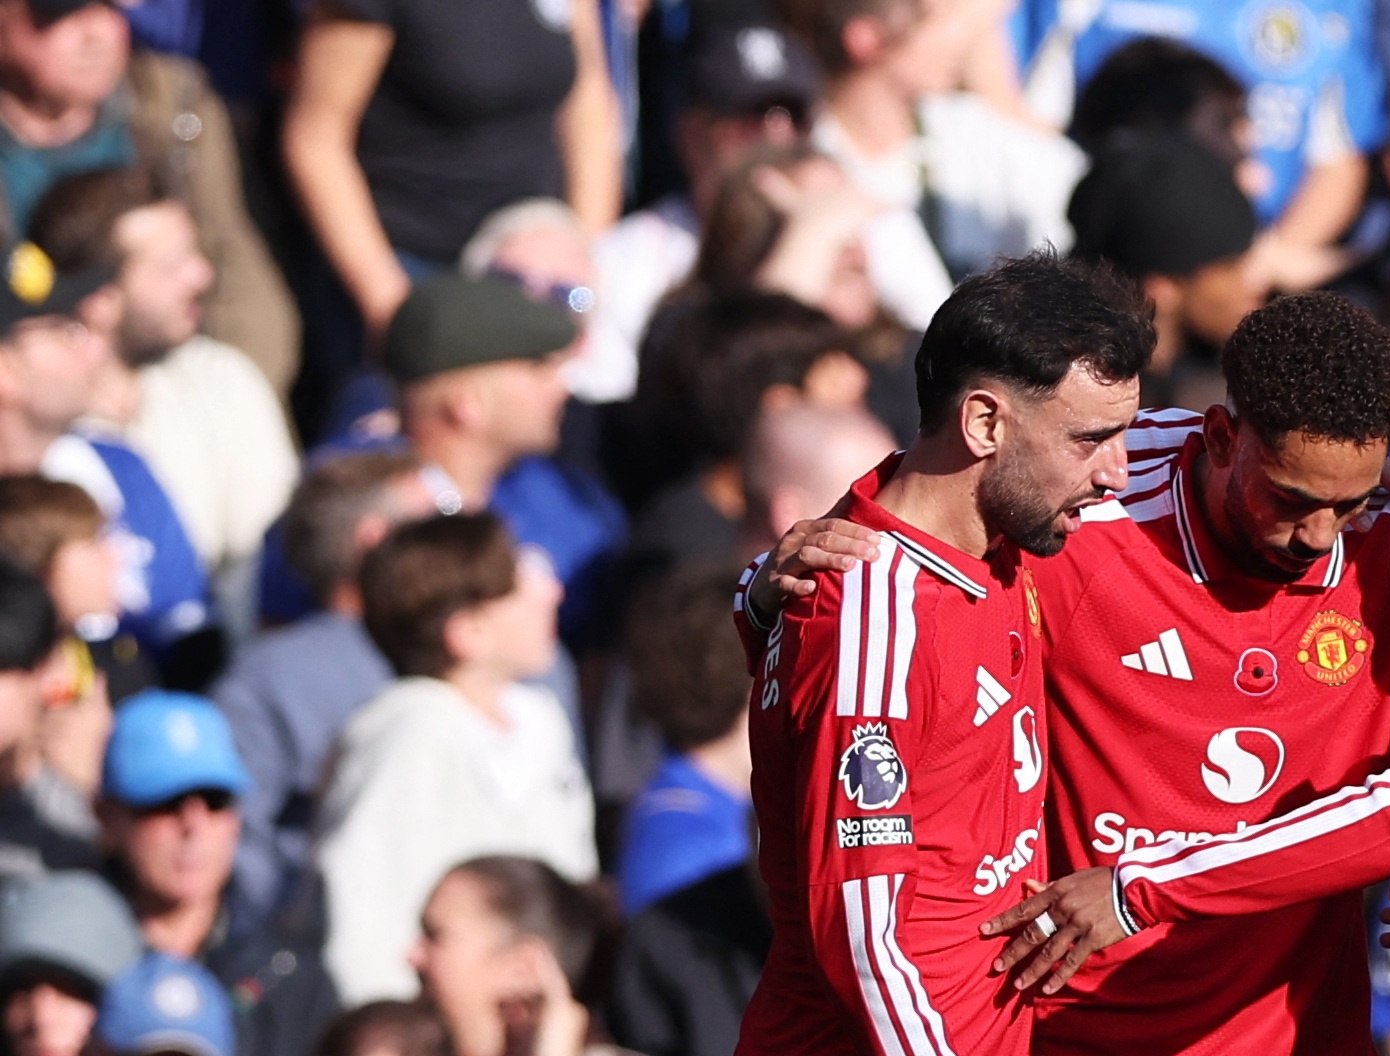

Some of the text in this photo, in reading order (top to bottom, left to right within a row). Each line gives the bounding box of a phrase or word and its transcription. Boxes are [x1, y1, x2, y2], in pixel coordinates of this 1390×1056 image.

[836, 817, 905, 834] No room
[862, 830, 912, 846] racism
